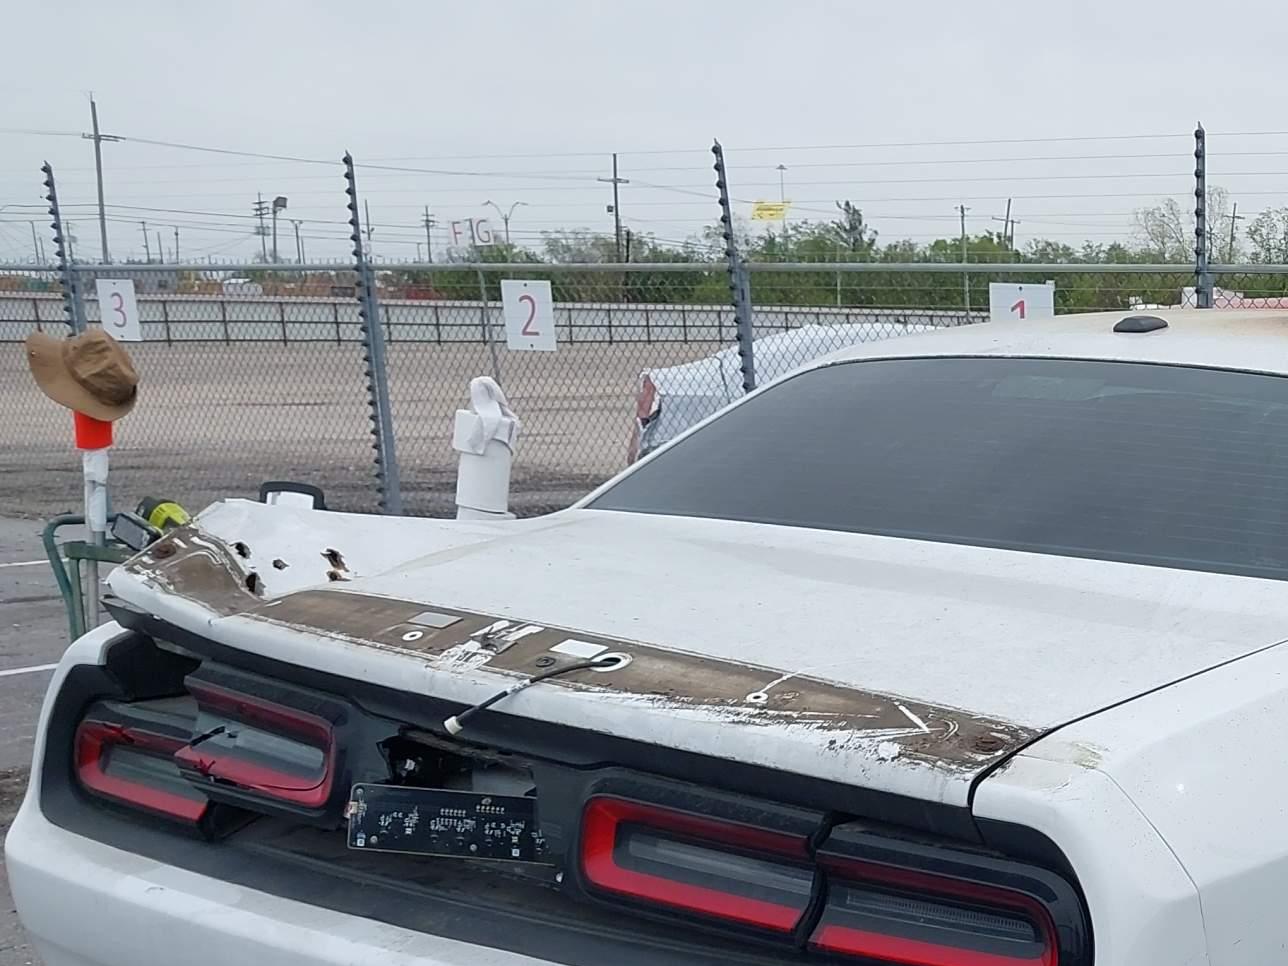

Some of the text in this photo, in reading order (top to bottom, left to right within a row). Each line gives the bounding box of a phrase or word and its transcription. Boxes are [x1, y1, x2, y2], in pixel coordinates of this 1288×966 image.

[475, 219, 491, 243] G
[111, 292, 127, 328] 3
[519, 295, 540, 336] 2
[1011, 300, 1025, 319] 1
